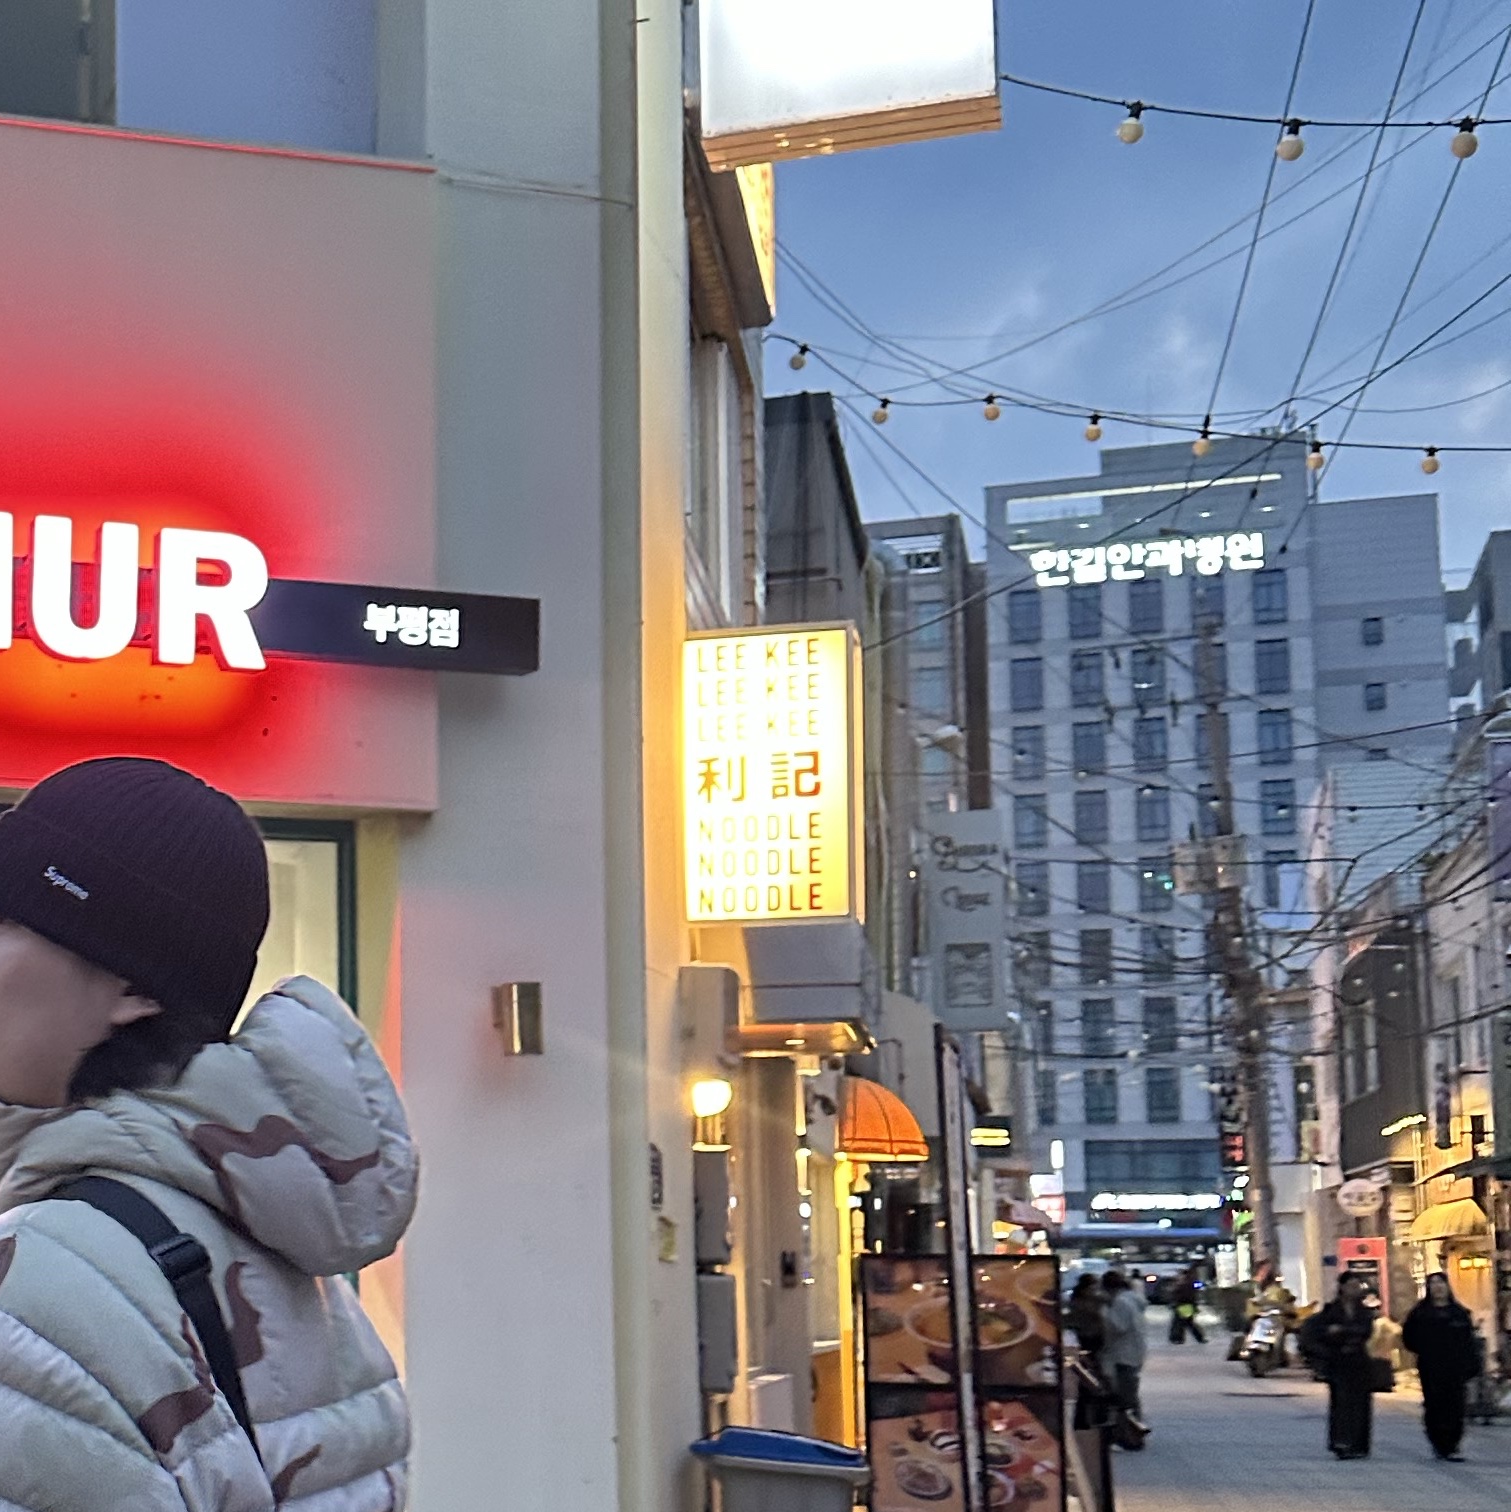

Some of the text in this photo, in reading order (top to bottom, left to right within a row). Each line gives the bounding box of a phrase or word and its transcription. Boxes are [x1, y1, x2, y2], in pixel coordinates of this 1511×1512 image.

[363, 603, 460, 648] 부평점
[697, 638, 820, 673] LEE KEE
[697, 673, 820, 707] LEE KEE
[697, 708, 820, 742] LEE KEE
[698, 812, 821, 843] NOODLE
[698, 847, 822, 877] NOODLE
[698, 883, 823, 913] NOODLE
